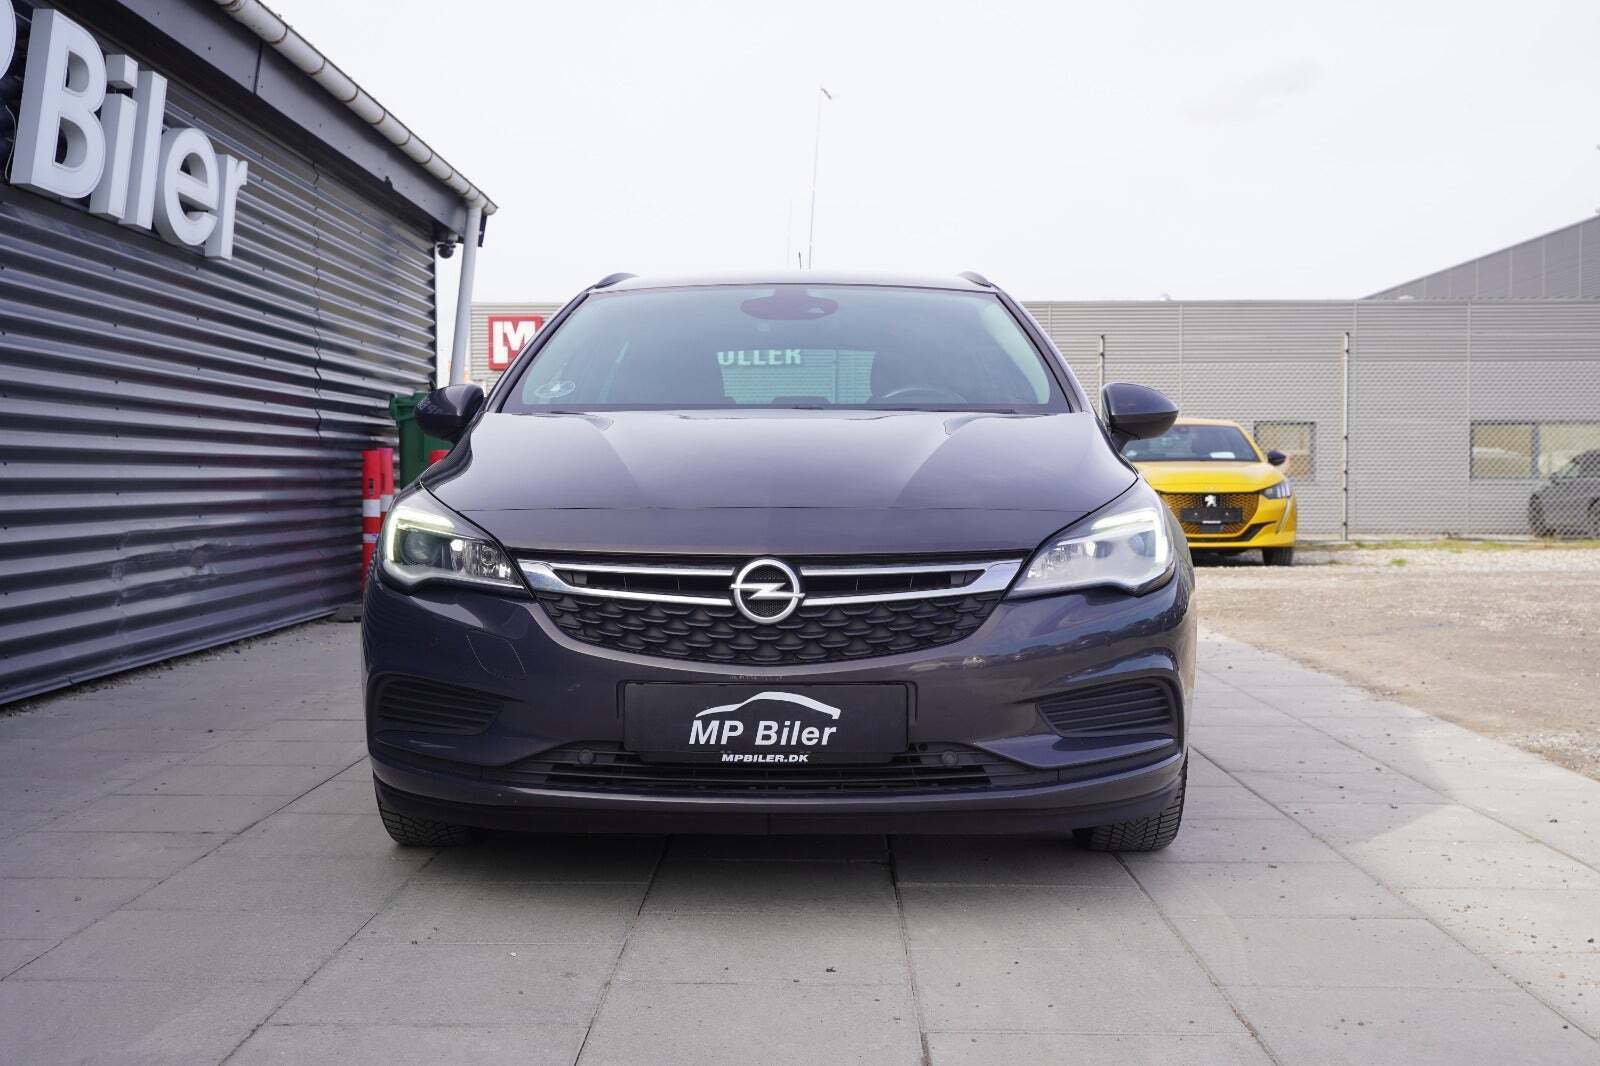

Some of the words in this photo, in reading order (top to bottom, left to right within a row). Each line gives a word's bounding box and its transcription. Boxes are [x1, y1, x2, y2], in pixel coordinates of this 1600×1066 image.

[10, 8, 248, 260] Biler
[689, 720, 744, 745] MP
[754, 720, 837, 746] Biler
[721, 754, 809, 763] MPBILER.DK
